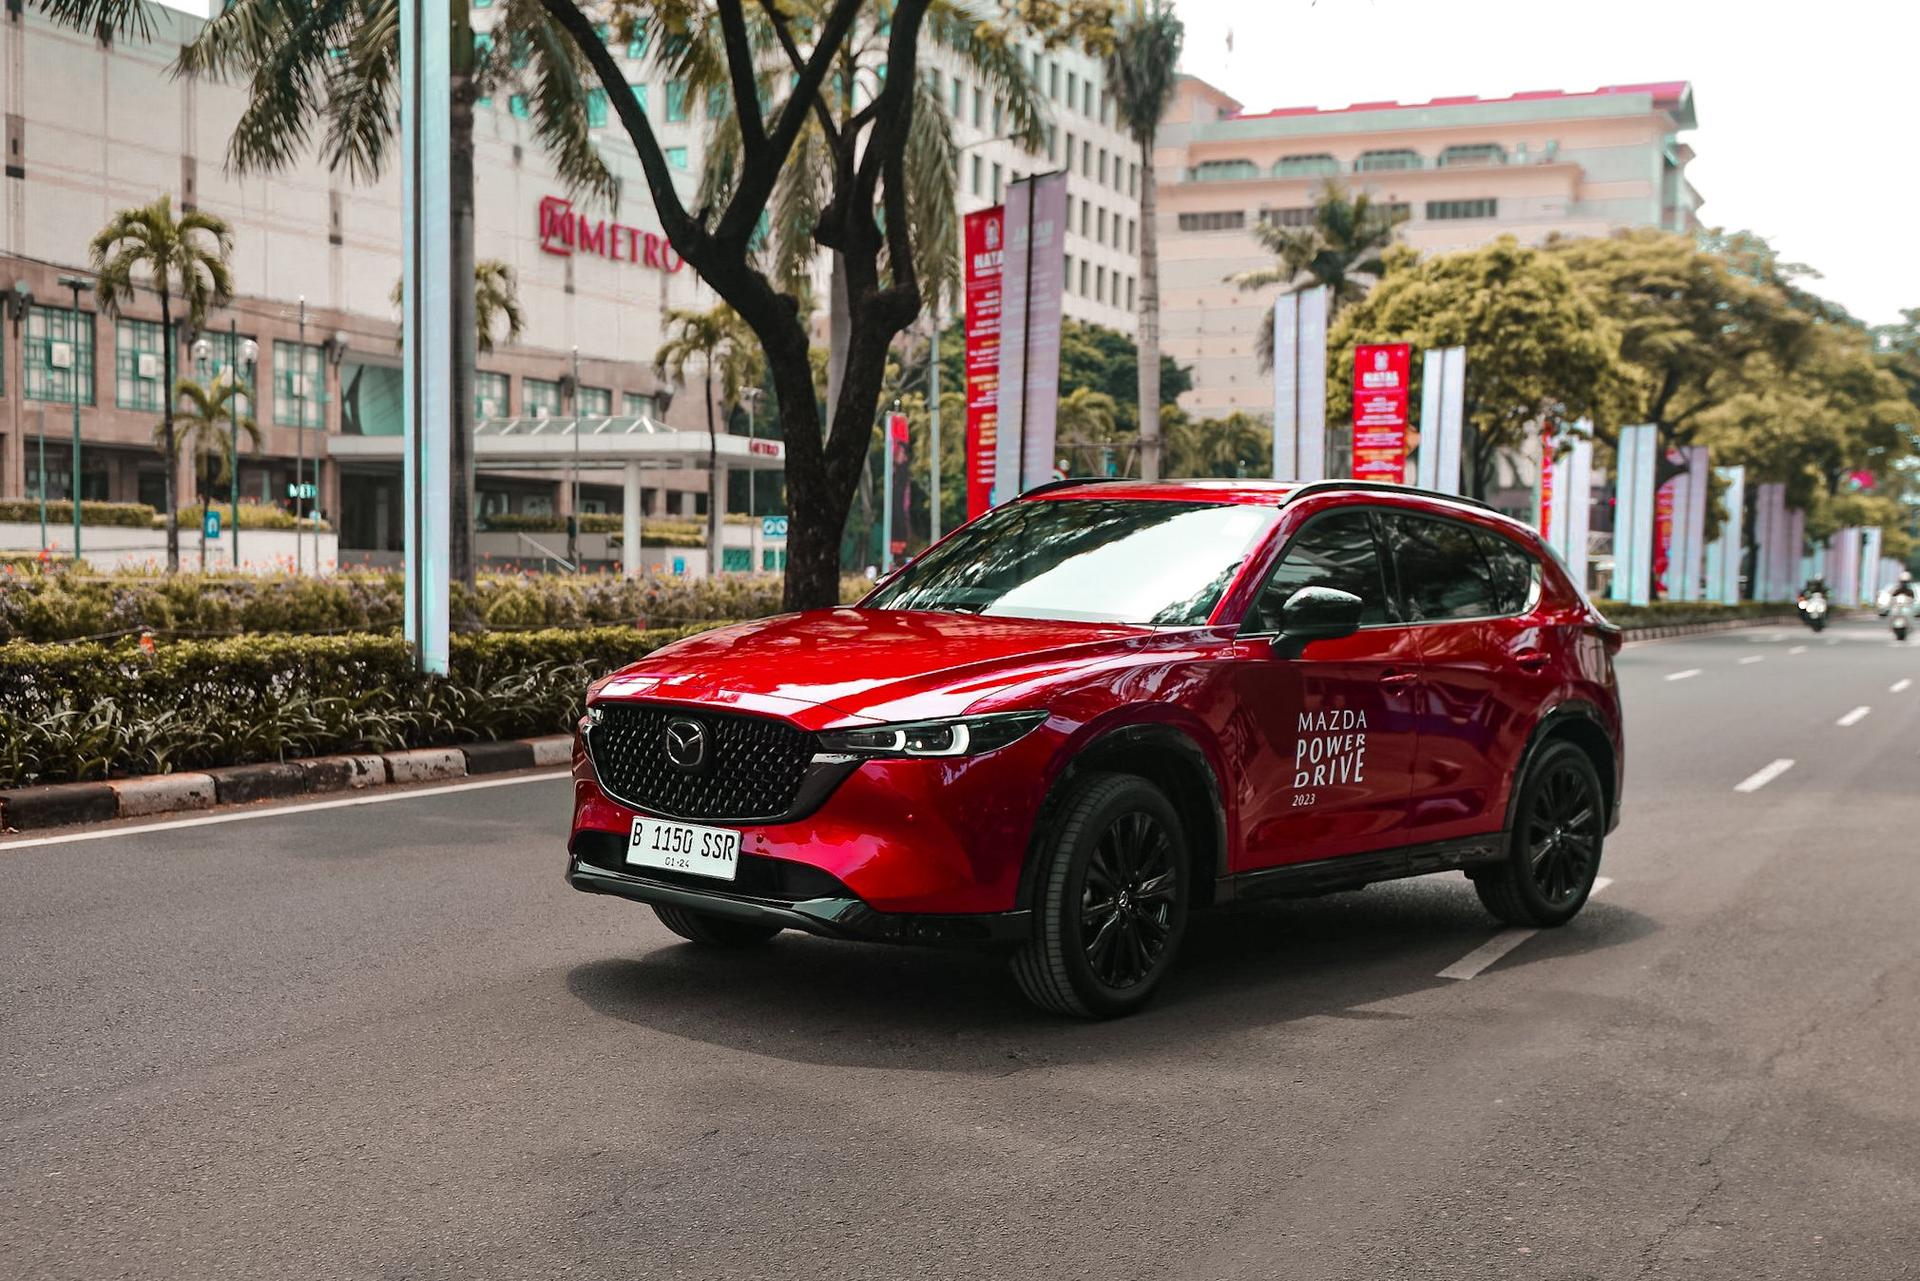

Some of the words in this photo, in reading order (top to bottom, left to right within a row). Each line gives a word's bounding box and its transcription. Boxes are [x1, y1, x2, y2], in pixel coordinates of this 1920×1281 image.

[579, 214, 684, 273] METRO
[1298, 710, 1367, 732] MAZDA
[1294, 748, 1366, 788] DRIVE
[1296, 734, 1366, 770] POWER
[1292, 794, 1316, 807] 2023
[632, 823, 643, 846] B
[652, 826, 693, 854] 1150
[701, 833, 735, 861] SSR
